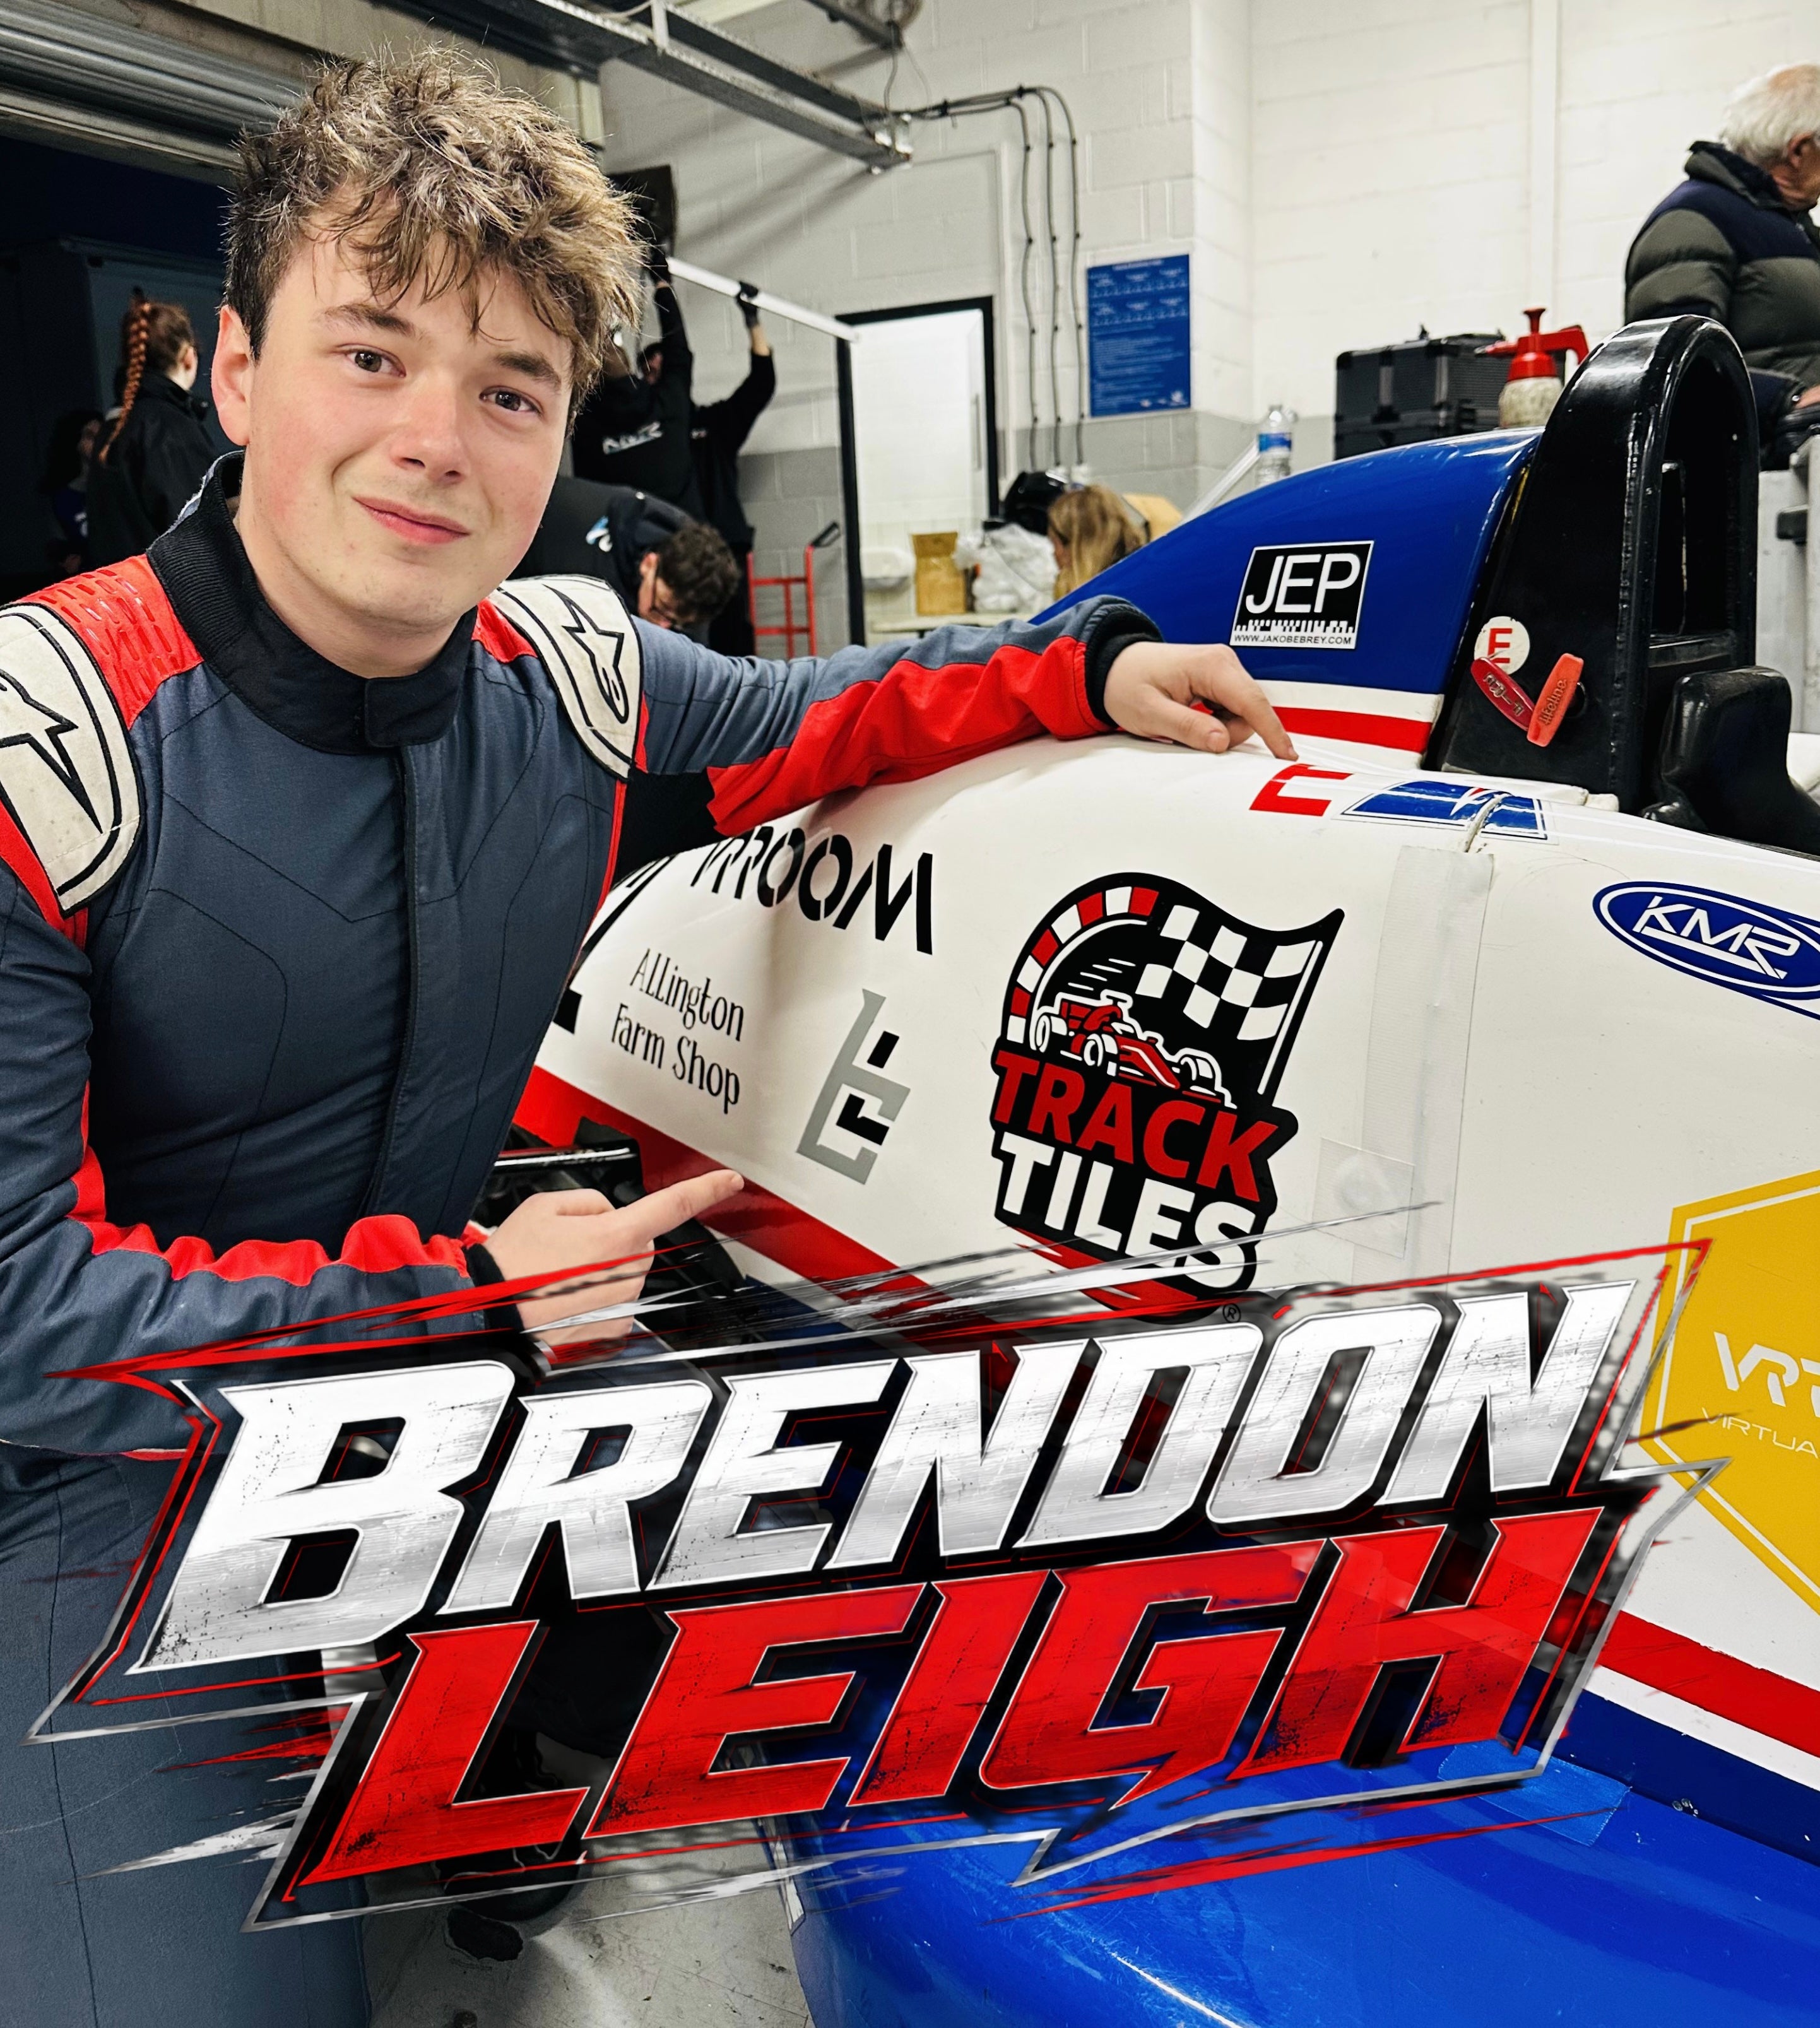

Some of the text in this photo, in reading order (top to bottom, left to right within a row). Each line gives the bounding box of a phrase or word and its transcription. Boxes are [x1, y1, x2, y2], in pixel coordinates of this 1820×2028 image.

[1246, 553, 1361, 614] JEP
[1234, 634, 1352, 645] WWW.JAKOBEBREY.COM
[1487, 628, 1513, 664] E
[1632, 895, 1800, 979] KMR
[612, 1003, 740, 1114] Farm Shop
[994, 1050, 1279, 1202] TRACK
[1000, 1131, 1256, 1288] TILES
